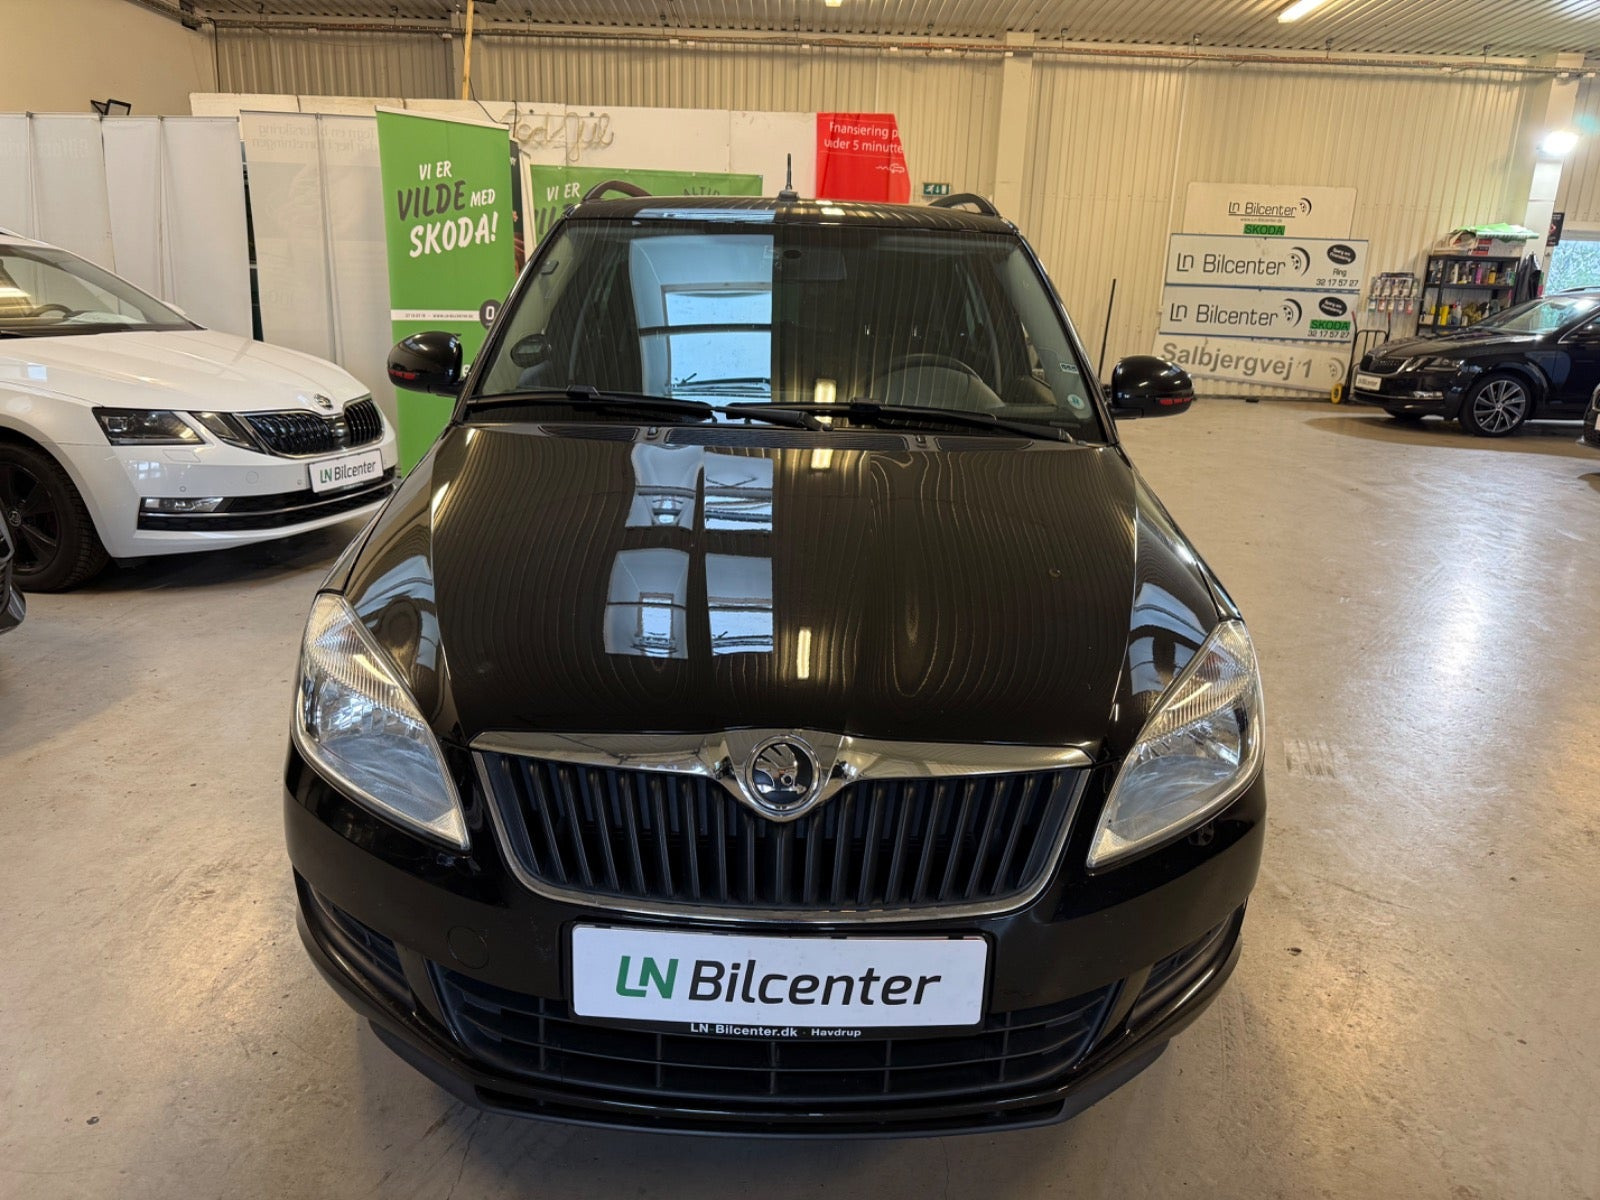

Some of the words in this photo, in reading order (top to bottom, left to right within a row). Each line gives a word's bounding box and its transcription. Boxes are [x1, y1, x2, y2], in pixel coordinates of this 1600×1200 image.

[829, 121, 889, 140] Fnansiering
[853, 140, 859, 151] 5
[861, 140, 904, 153] minutte
[419, 163, 432, 180] VI
[436, 160, 453, 178] ER
[397, 180, 466, 222] VILDE
[470, 188, 495, 207] MED
[547, 185, 559, 202] VI
[564, 182, 580, 198] ER
[1245, 202, 1297, 216] Bilcenter
[409, 211, 499, 258] SKODA!
[1244, 224, 1286, 235] SKODA
[1203, 253, 1286, 276] Bilcenter
[1333, 267, 1347, 278] Ring
[1316, 278, 1326, 286] 32
[1196, 303, 1278, 326] Bilcenter
[1310, 320, 1350, 330] SKODA
[1161, 343, 1294, 381] Salbjergvej
[1302, 359, 1313, 379] 1
[320, 467, 333, 484] LN
[334, 461, 376, 481] Bilcenter
[615, 955, 679, 999] LN
[688, 959, 942, 1006] Bilcenter
[811, 1027, 862, 1039] Havdrup
